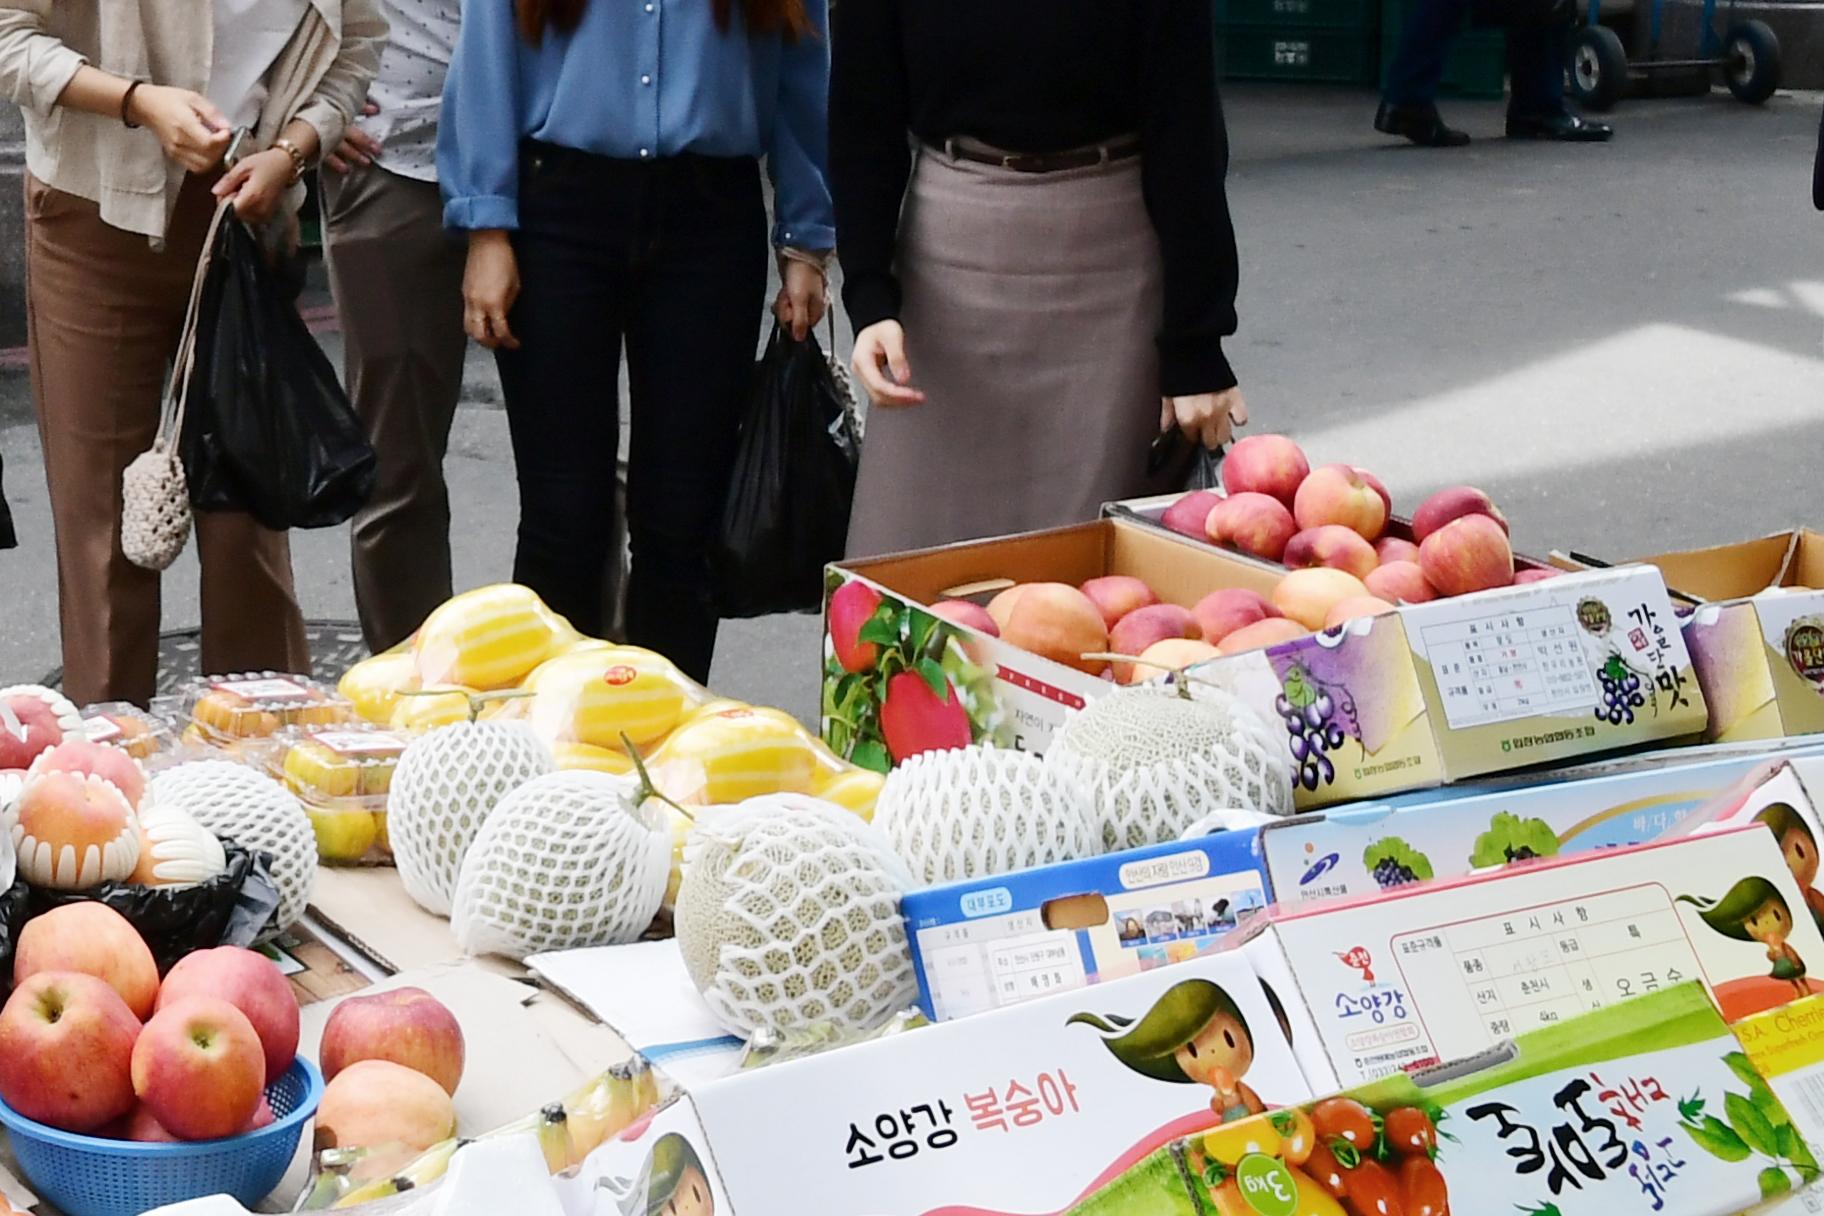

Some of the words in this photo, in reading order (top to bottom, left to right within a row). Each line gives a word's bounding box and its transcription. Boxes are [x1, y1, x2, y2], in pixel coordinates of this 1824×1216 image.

[966, 893, 1007, 912] 대부포도
[1625, 923, 1641, 939] 특
[1558, 937, 1580, 953] 등급
[1475, 987, 1498, 1004] 산지
[1519, 977, 1551, 995] 춘천시
[1335, 989, 1408, 1024] 소양강
[844, 1098, 959, 1170] 소양강
[963, 1067, 1081, 1133] 복숭아
[1464, 1078, 1629, 1196] 토마토
[1243, 1170, 1292, 1202] 3kg
